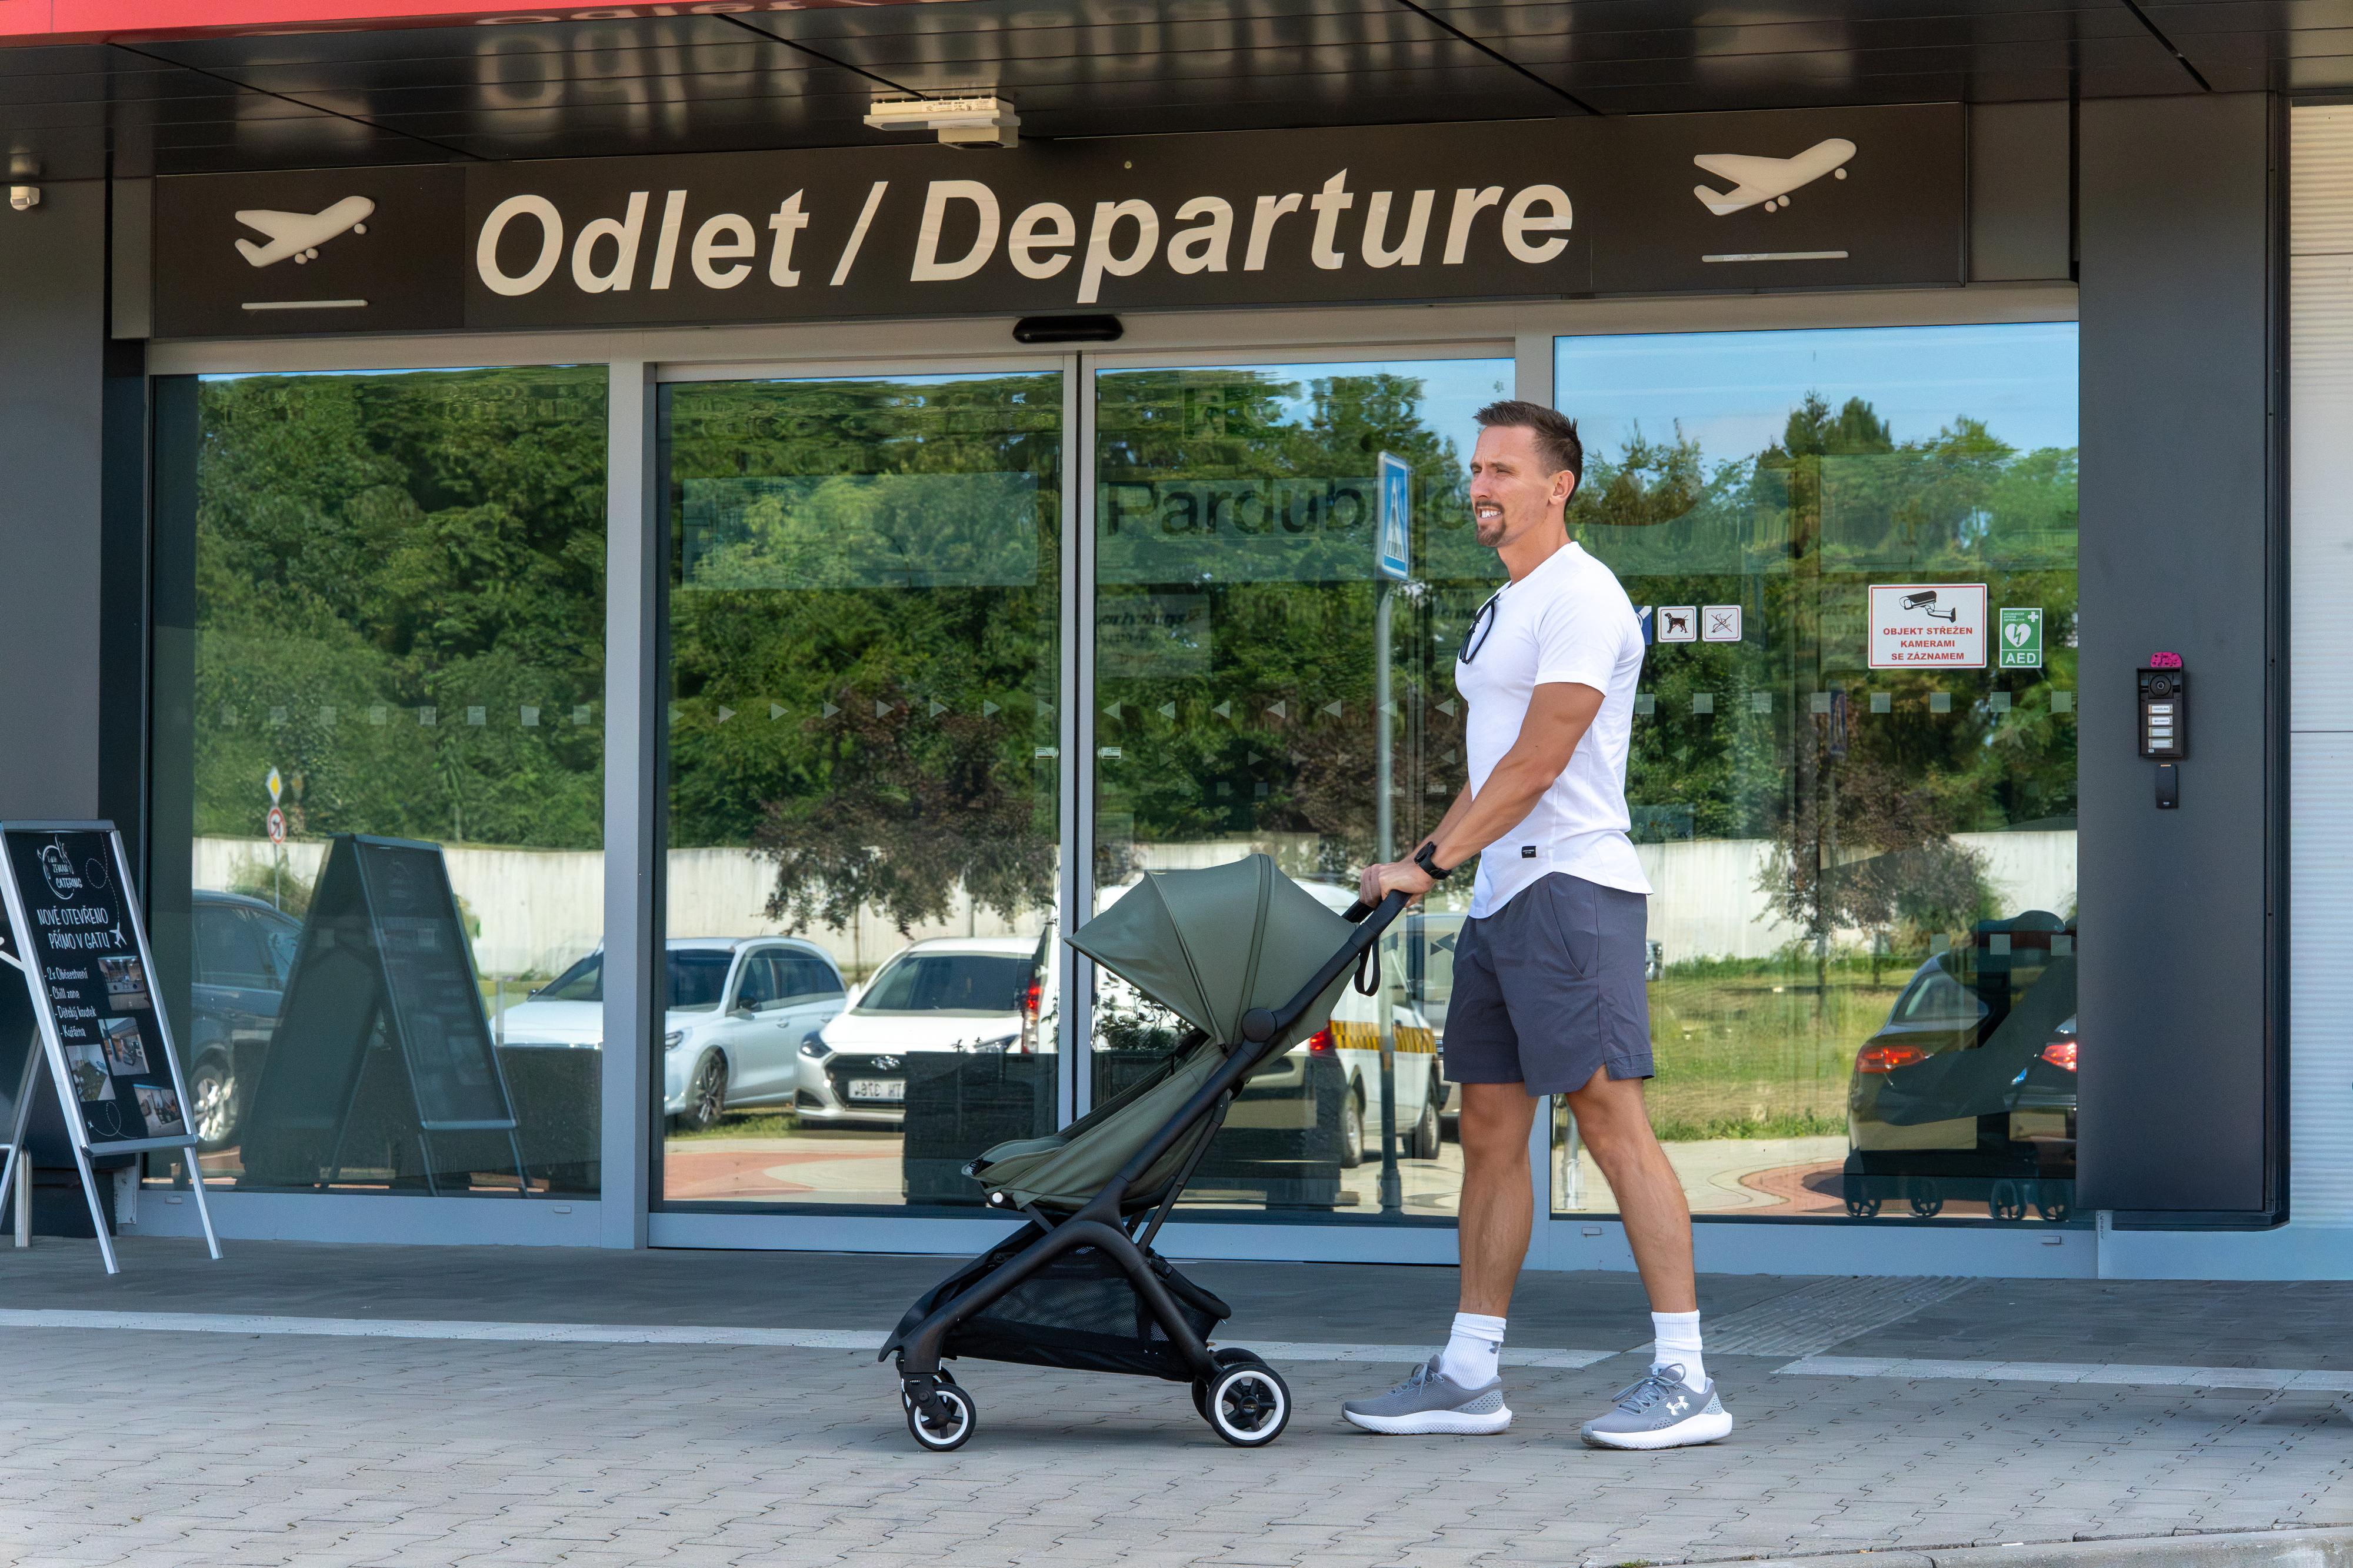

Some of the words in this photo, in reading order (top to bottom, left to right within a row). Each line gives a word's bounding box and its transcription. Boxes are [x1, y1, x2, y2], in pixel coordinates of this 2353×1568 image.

[476, 188, 809, 296] Odlet
[829, 181, 888, 285] /
[909, 168, 1573, 303] Departure
[1926, 626, 1972, 635] STŘEŽEN
[1907, 652, 1964, 660] ZÁZNAMEM
[2005, 652, 2037, 663] AED
[55, 878, 83, 889] CATERING
[36, 905, 62, 925] NOVĚ
[61, 905, 108, 925] OTEVŘENO
[48, 929, 76, 949] PŘÍMO
[75, 933, 83, 949] V
[84, 932, 111, 949] GATU
[46, 967, 56, 980] 2x
[52, 986, 66, 999] Chill
[66, 990, 80, 999] zone
[56, 1005, 78, 1020] Dětský
[77, 1005, 96, 1018] koutek
